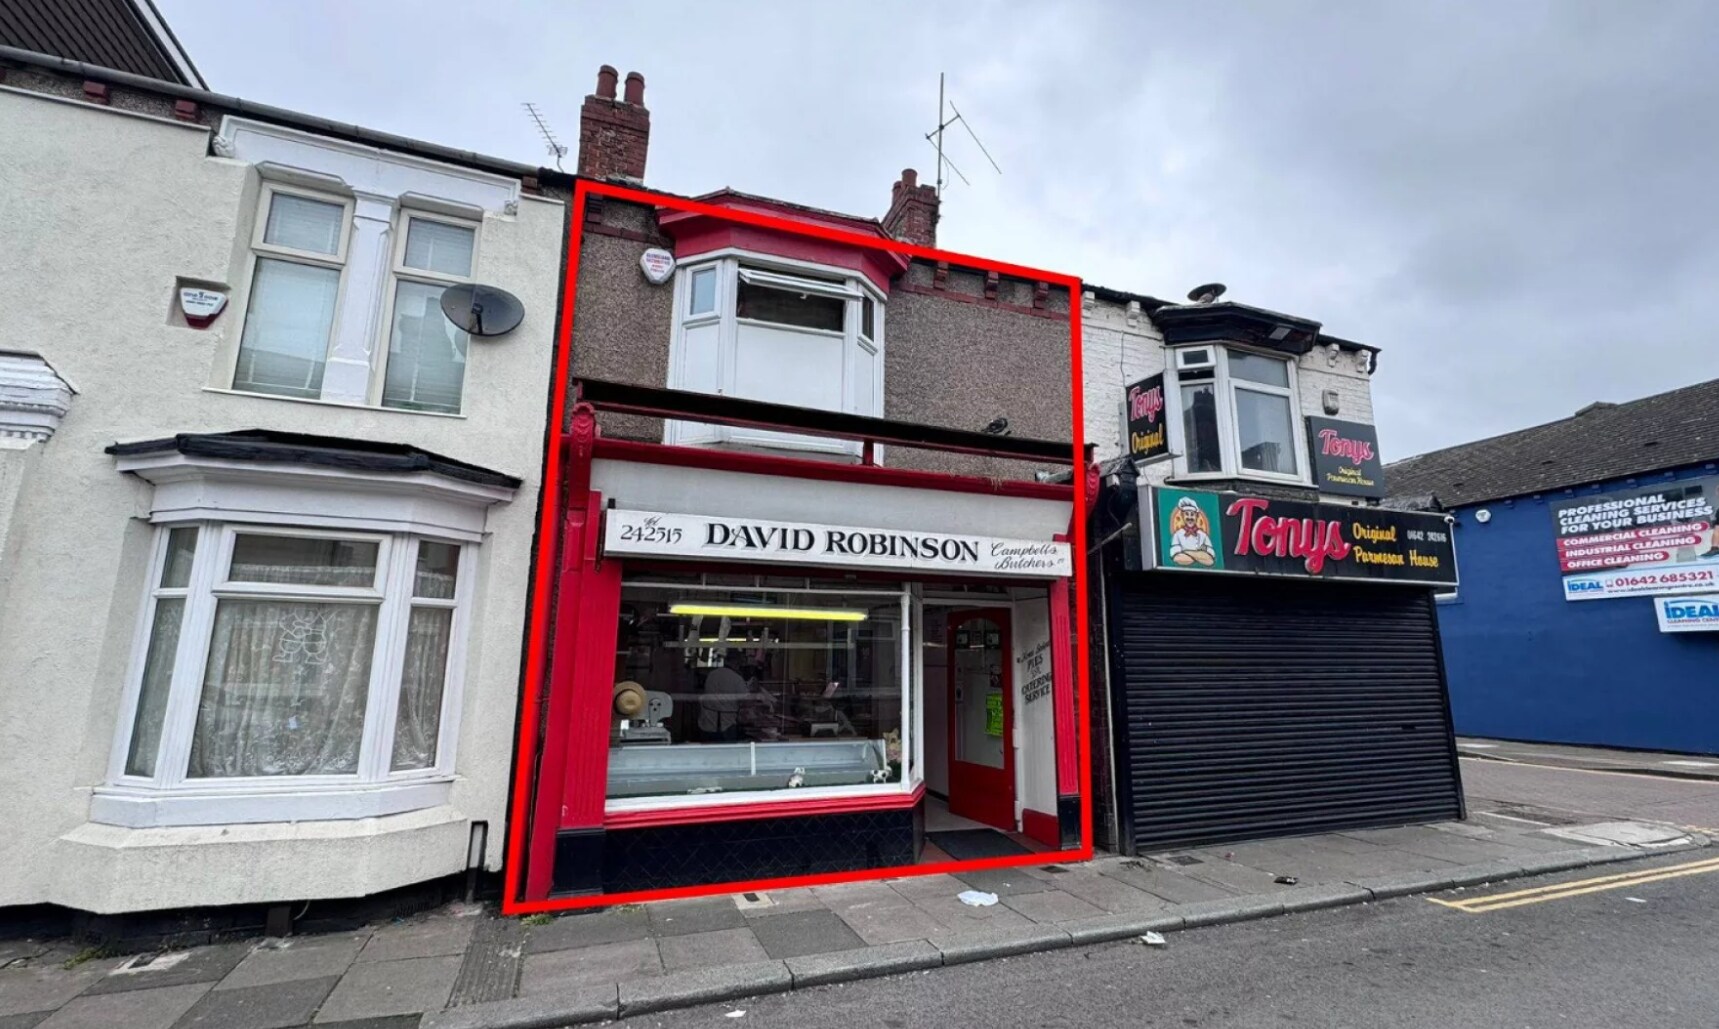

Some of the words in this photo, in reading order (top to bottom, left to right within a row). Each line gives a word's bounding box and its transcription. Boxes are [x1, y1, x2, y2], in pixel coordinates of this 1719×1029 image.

[1128, 385, 1163, 423] Tonys
[1132, 423, 1164, 455] Original
[1318, 428, 1375, 465] Tonys
[1558, 494, 1666, 518] PROFESSIONAL
[1560, 508, 1630, 526] CLEANING
[1633, 497, 1707, 516] SERVICES
[1561, 523, 1588, 535] FOR
[1592, 517, 1632, 530] YOUR
[1637, 506, 1713, 524] BUSINESS
[620, 524, 683, 544] 242515
[705, 522, 816, 552] DAVID
[825, 530, 979, 563] ROBINSON
[1226, 498, 1351, 574] Tonys
[1352, 522, 1398, 544] Original
[1563, 531, 1637, 546] COMMERCIAL
[1638, 523, 1702, 537] CLEANING
[1353, 545, 1405, 566] Parmesan
[1409, 549, 1439, 568] House
[1566, 543, 1631, 557] INDUSTRIAL
[1632, 536, 1696, 550] CLEANING
[994, 556, 1054, 570] Butchers
[1567, 558, 1604, 568] OFFICE
[1604, 552, 1664, 565] CLEANING
[1615, 575, 1657, 587] 01642
[1660, 570, 1714, 583] 685321
